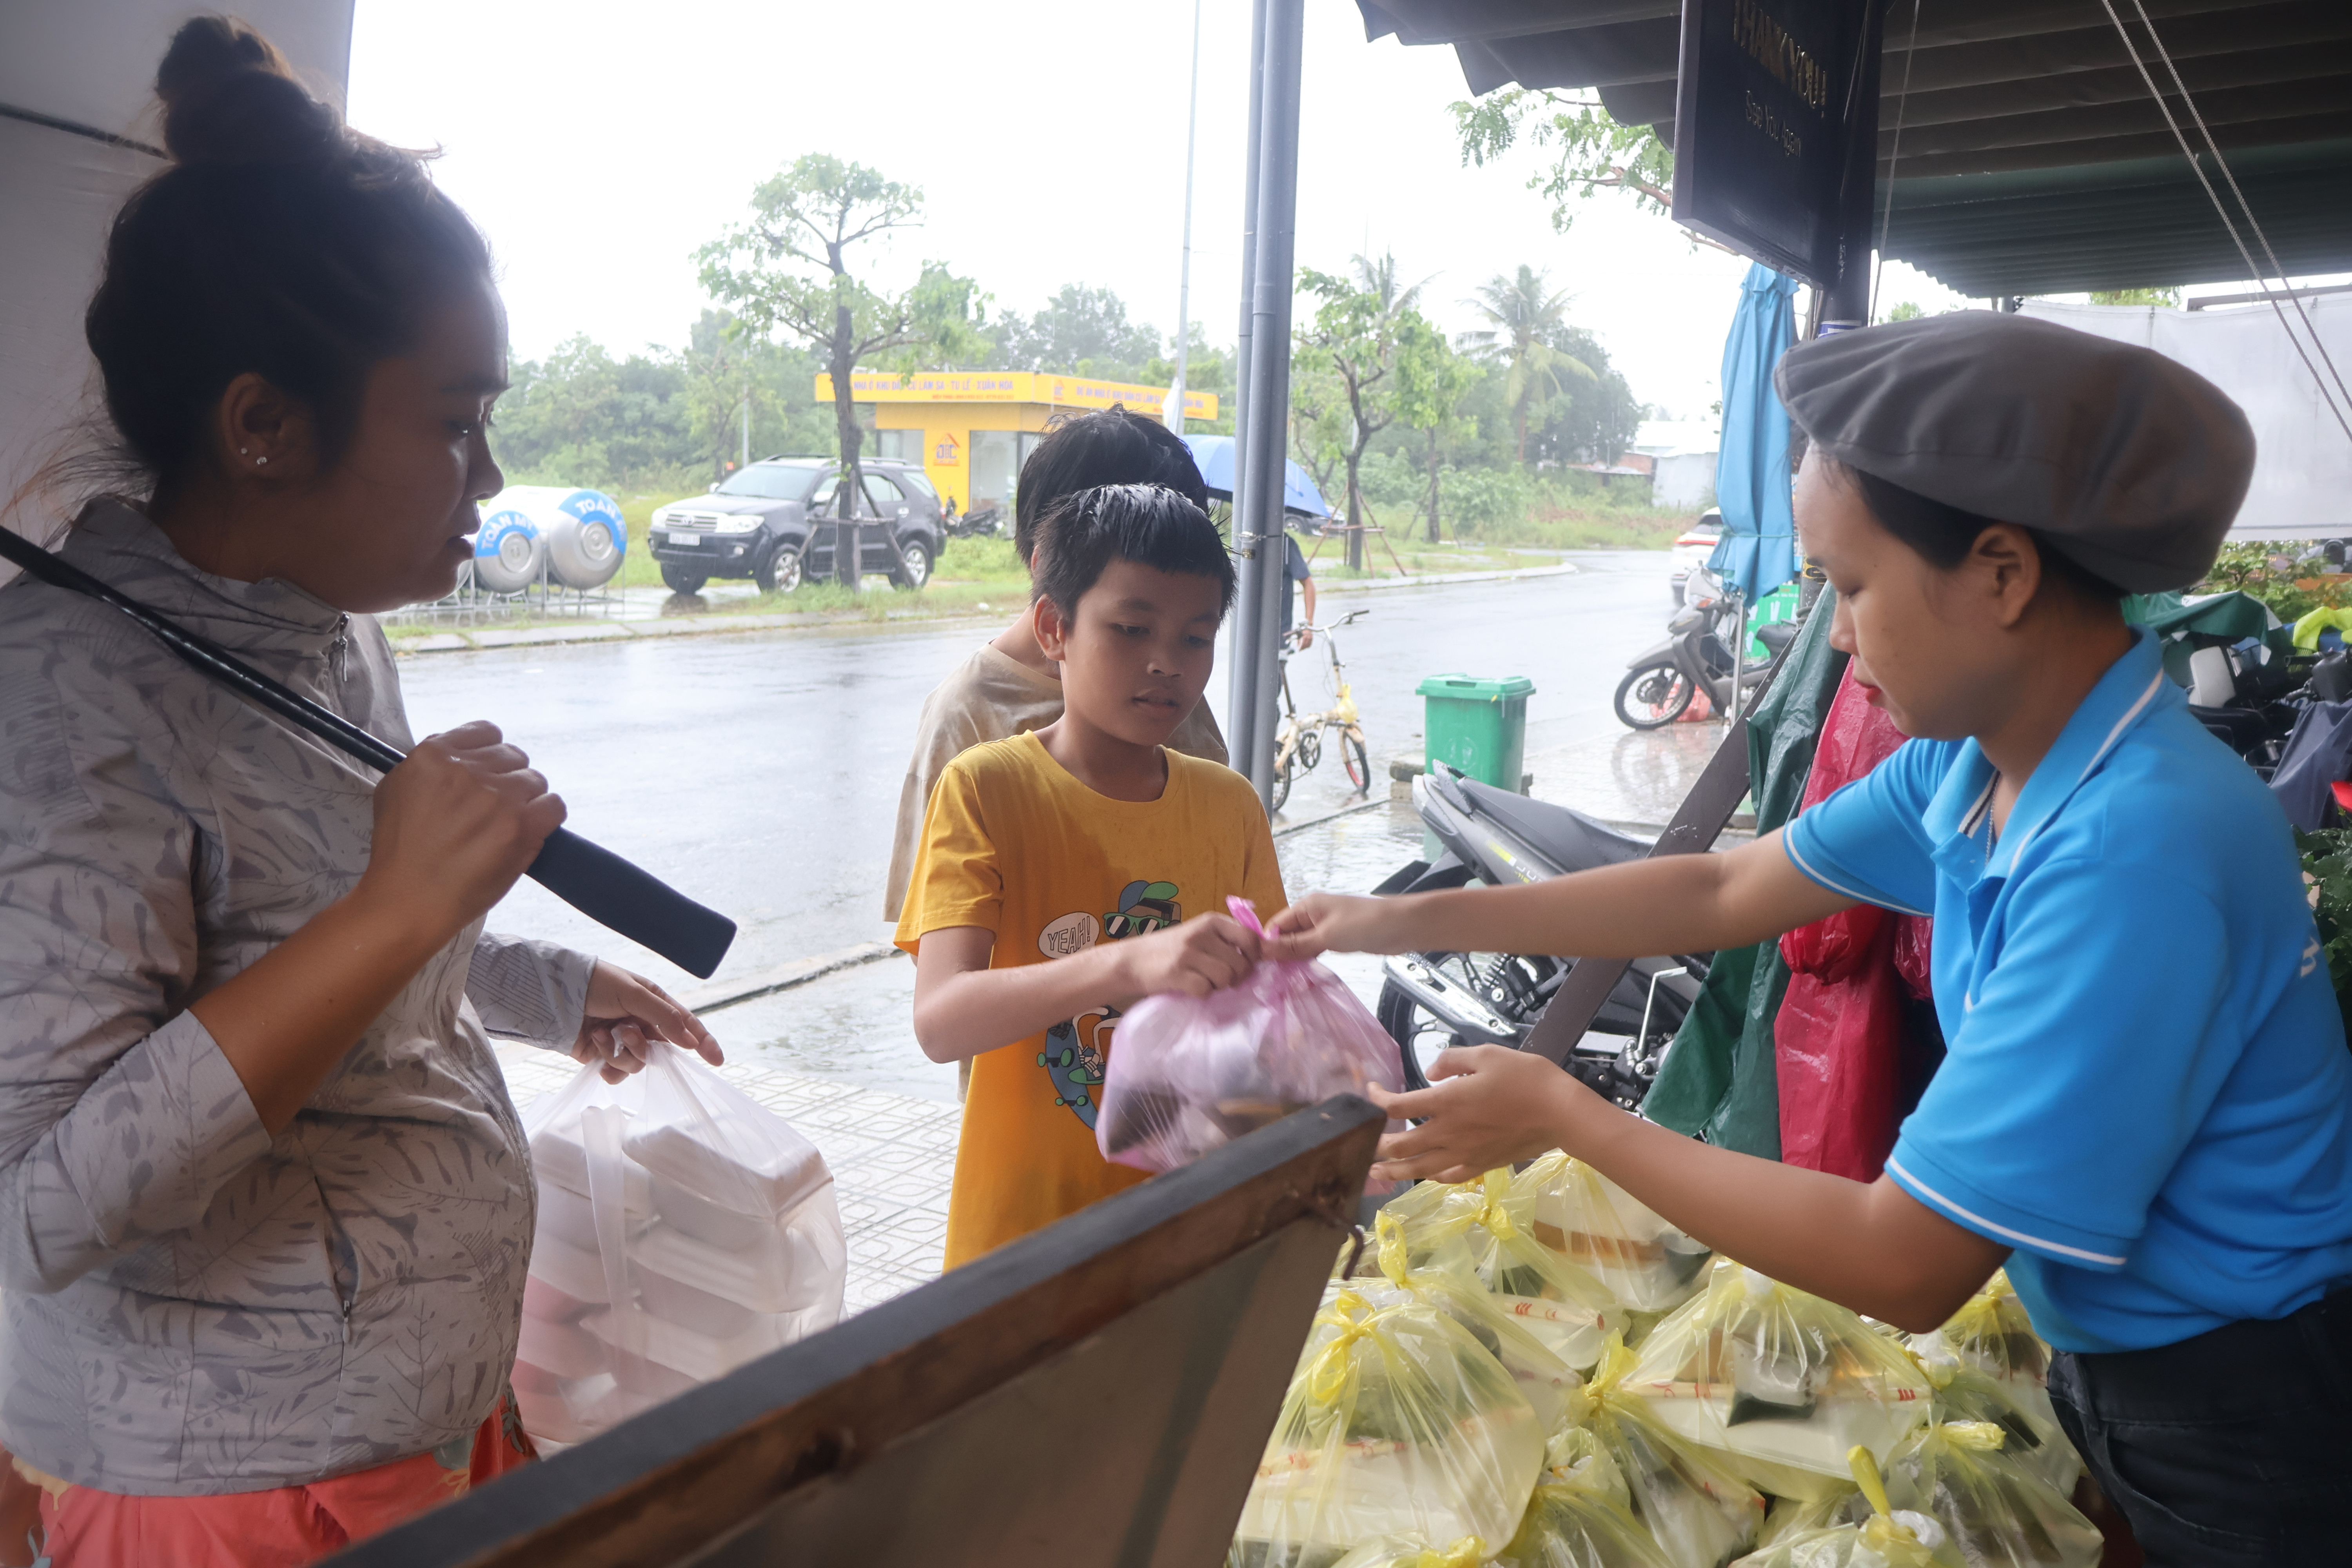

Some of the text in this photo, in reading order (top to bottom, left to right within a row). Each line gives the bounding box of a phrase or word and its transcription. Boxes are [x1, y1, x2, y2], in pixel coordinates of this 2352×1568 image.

[1745, 89, 1763, 130] See
[936, 381, 945, 390] SA
[1047, 916, 1091, 954] YEAH!
